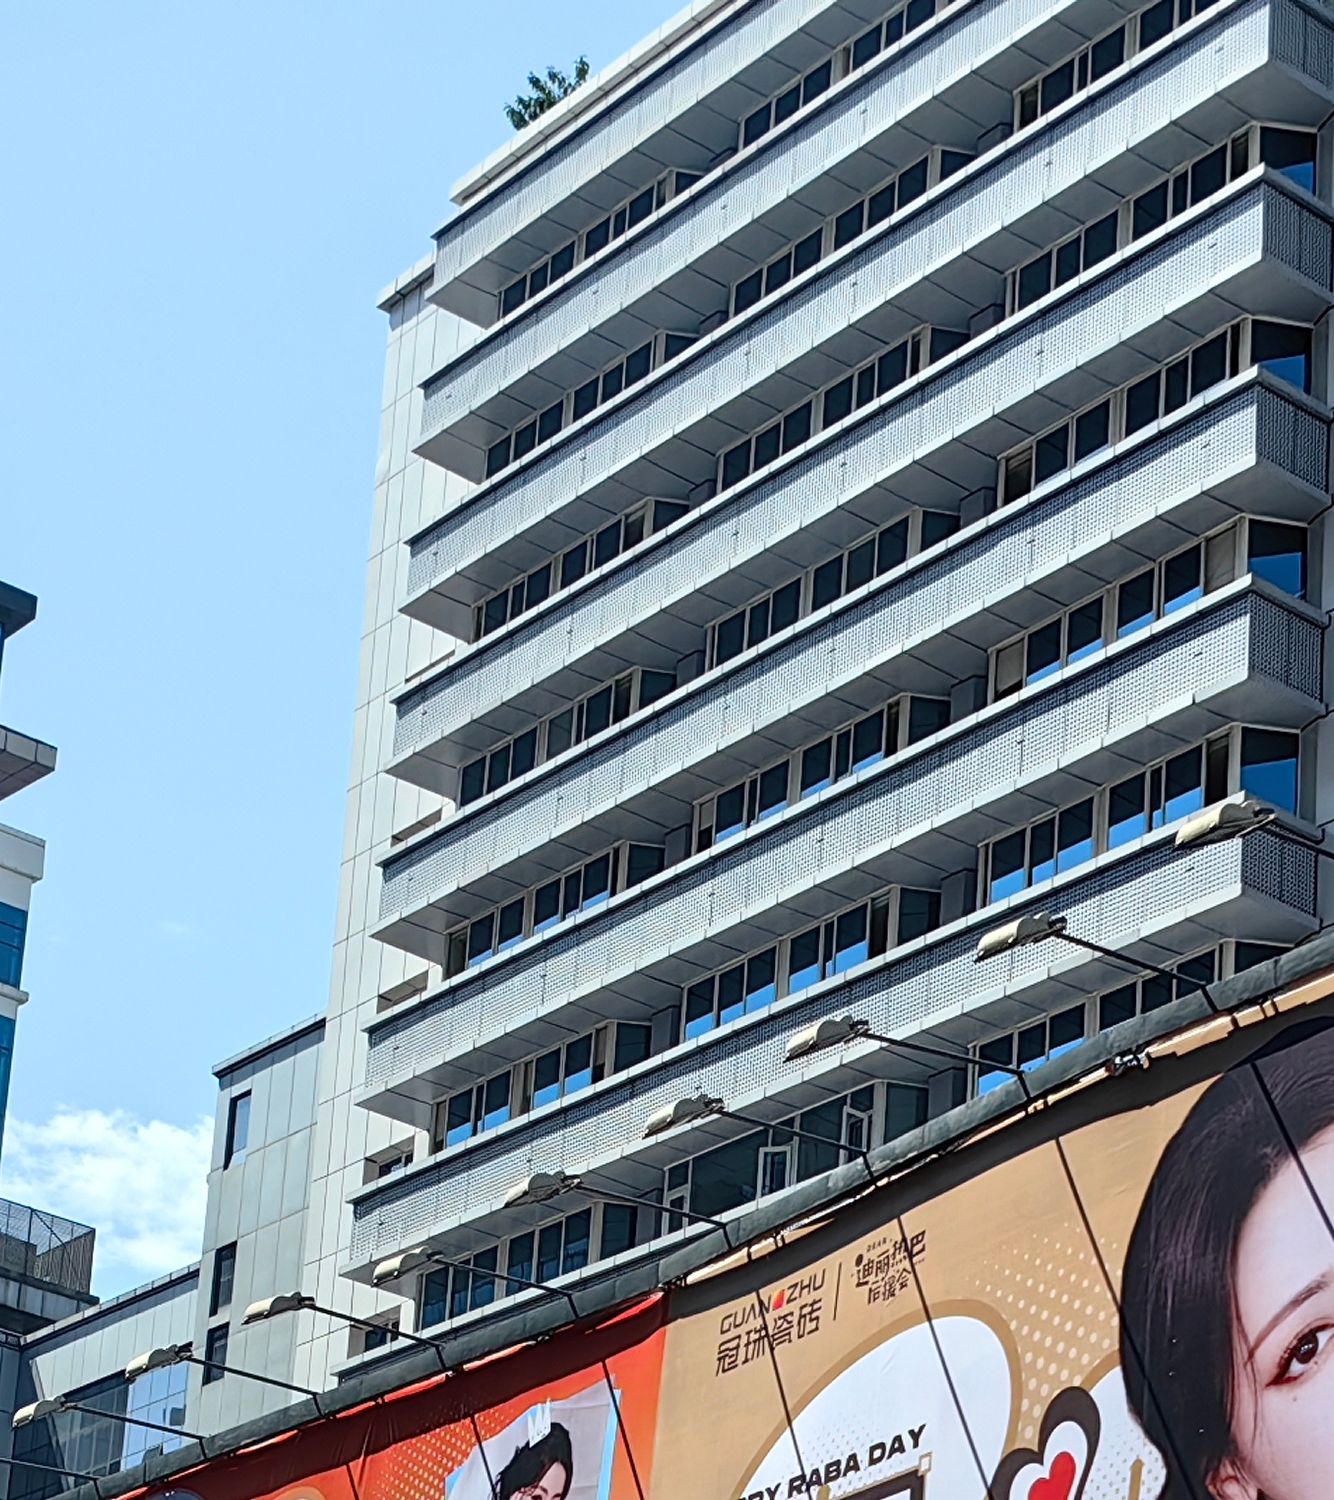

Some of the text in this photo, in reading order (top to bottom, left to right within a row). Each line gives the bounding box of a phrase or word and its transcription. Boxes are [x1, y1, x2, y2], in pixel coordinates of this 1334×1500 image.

[716, 1298, 822, 1377] 冠珠瓷砖
[788, 1456, 859, 1498] RABA
[867, 1423, 927, 1469] DAY
